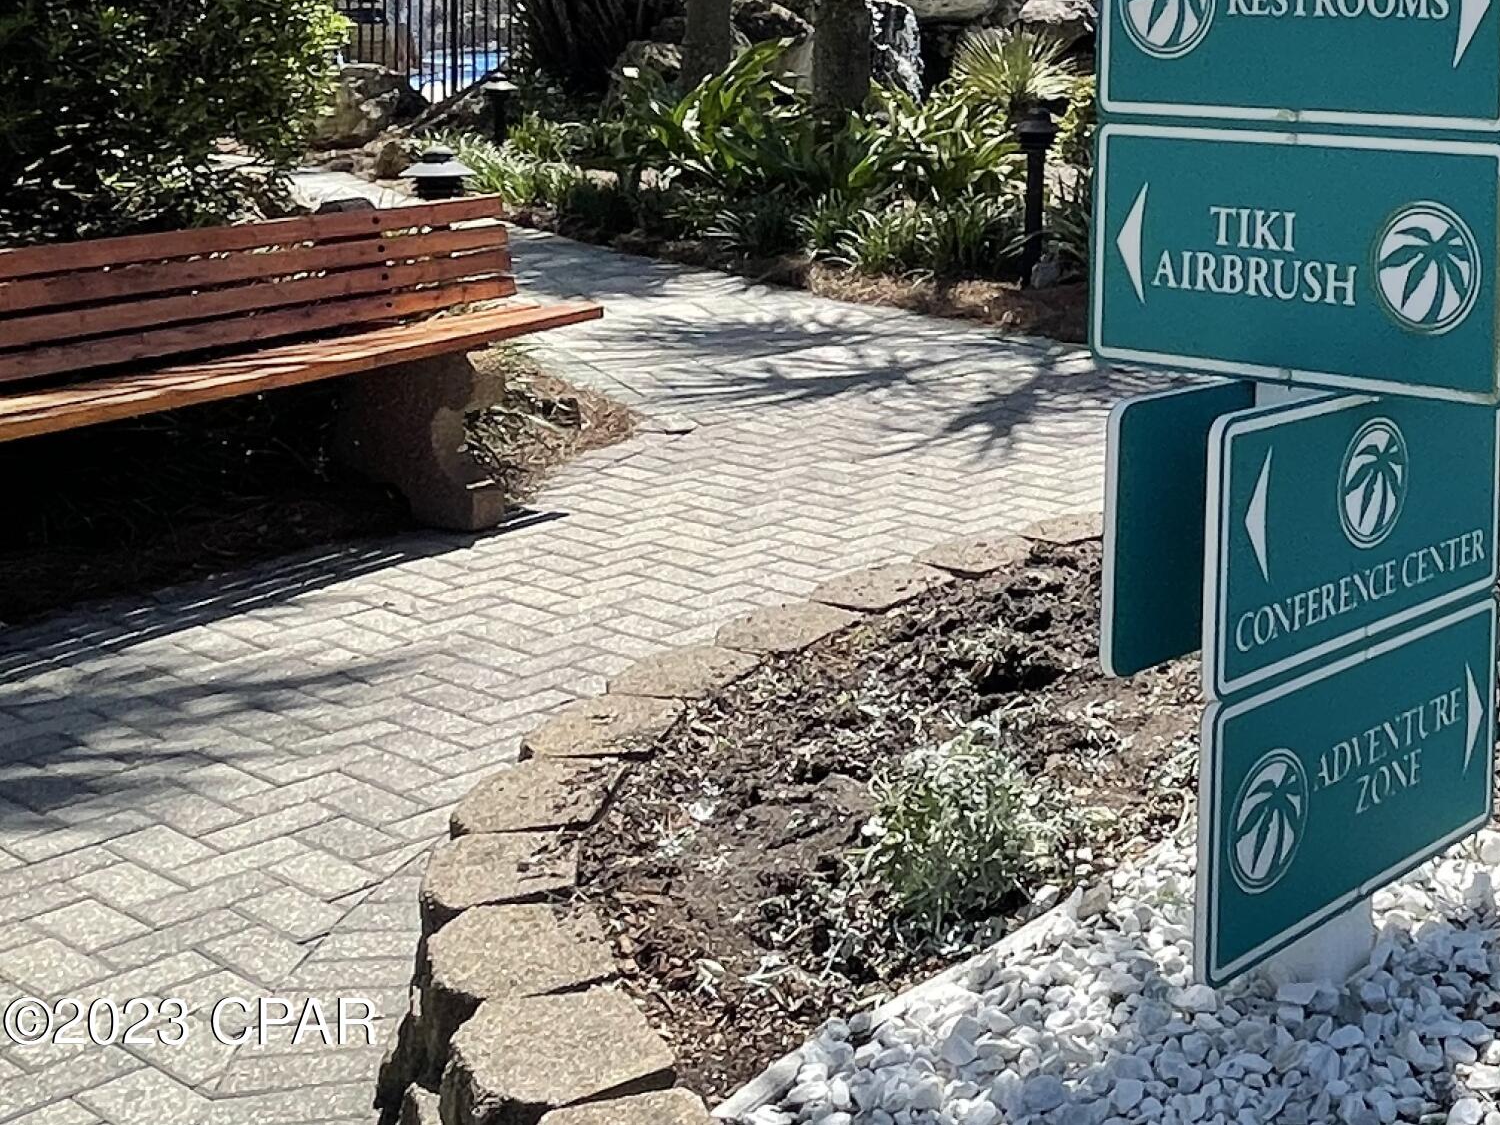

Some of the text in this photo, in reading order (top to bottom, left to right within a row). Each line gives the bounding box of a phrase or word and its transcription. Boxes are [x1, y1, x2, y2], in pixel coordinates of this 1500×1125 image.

[1210, 205, 1296, 252] TIKI
[1151, 250, 1357, 306] AIRBRUSH
[1235, 529, 1486, 652] CONFERENCE CENTER
[1313, 687, 1462, 791] ADVENTURE
[1355, 748, 1422, 815] ZONE
